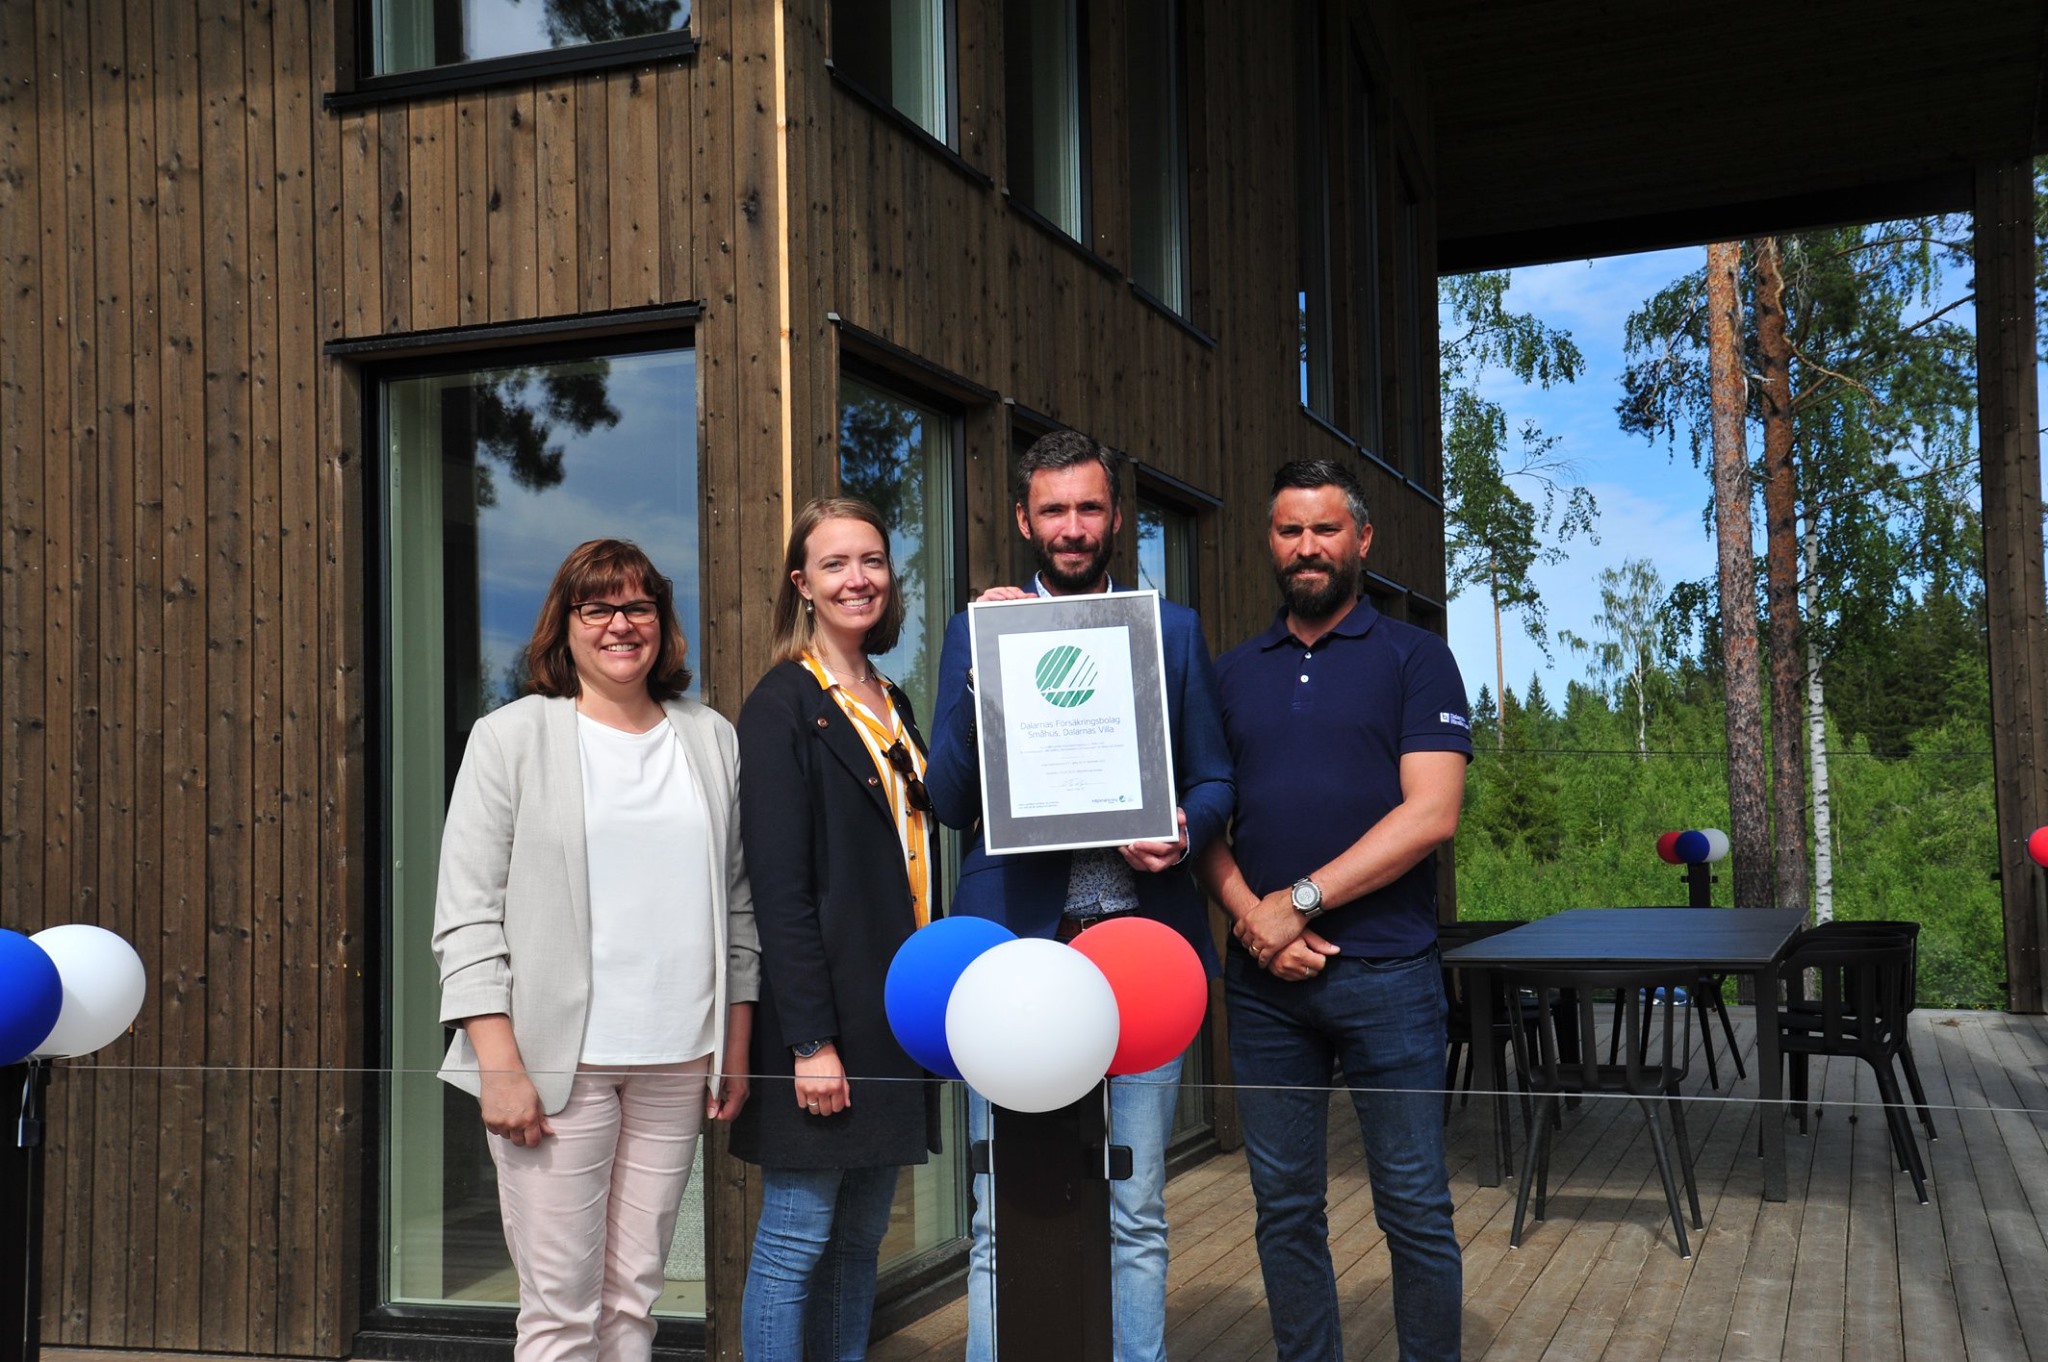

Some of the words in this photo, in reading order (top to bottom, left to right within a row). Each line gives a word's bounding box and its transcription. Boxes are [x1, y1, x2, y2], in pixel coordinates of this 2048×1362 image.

[1020, 721, 1053, 730] Dalarnas
[1063, 727, 1096, 736] Dalarnas
[1098, 724, 1115, 733] Villa
